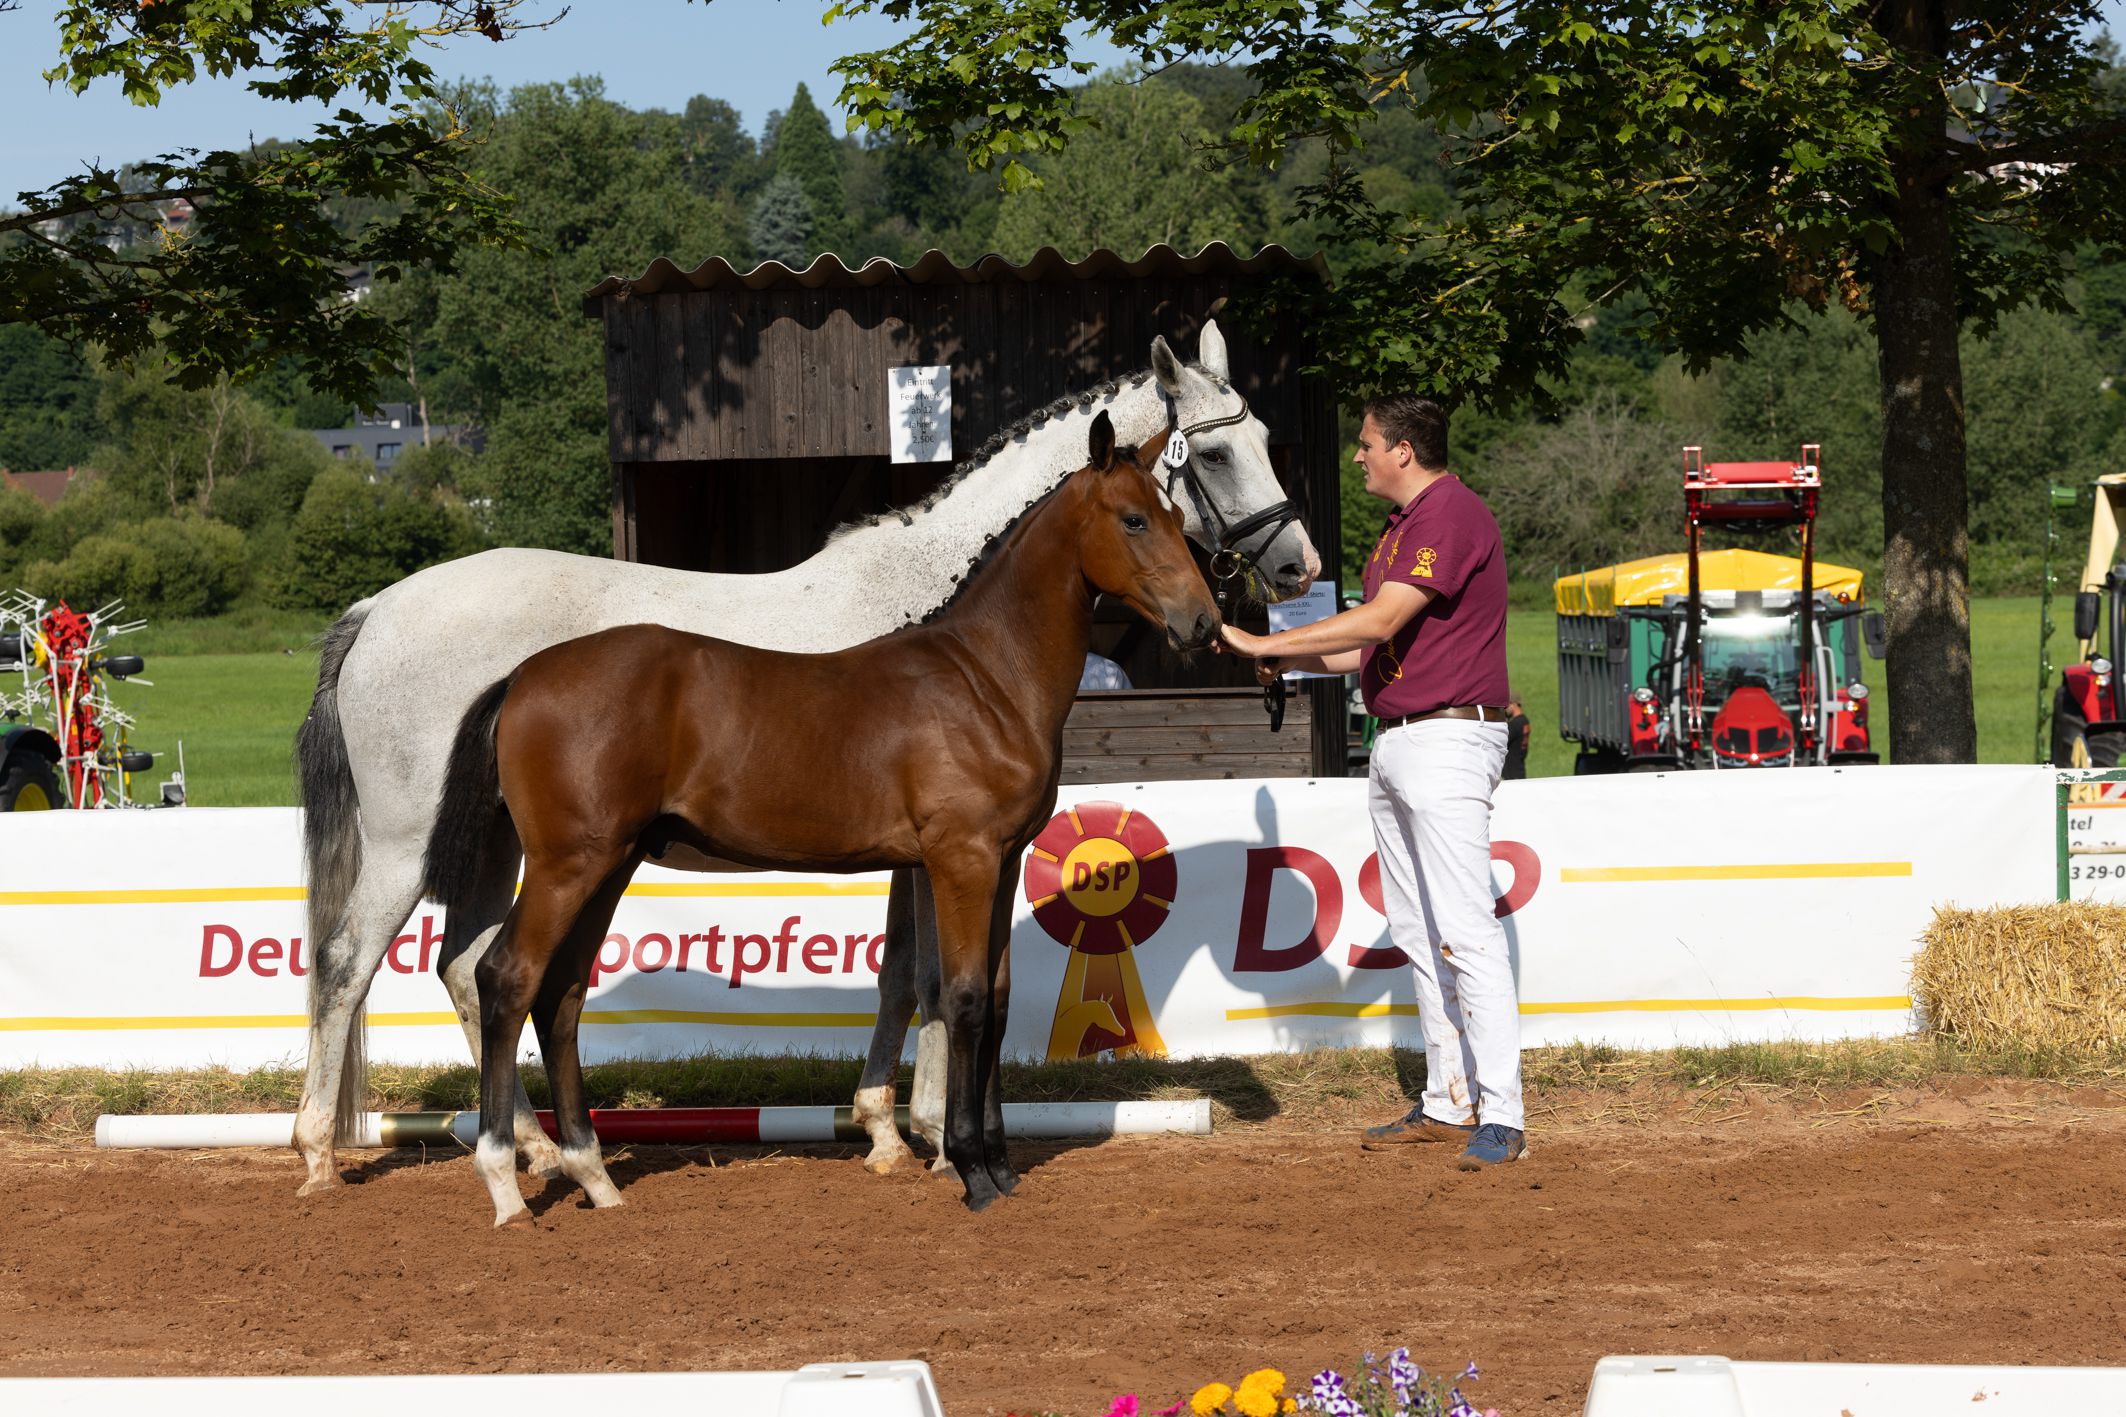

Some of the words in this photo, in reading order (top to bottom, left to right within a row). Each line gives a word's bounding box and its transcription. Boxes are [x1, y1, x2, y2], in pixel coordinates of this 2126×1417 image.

[911, 406, 921, 414] ab
[923, 406, 933, 414] 12
[1171, 440, 1184, 460] 15
[1072, 861, 1131, 892] DSP
[588, 915, 887, 989] portpfer
